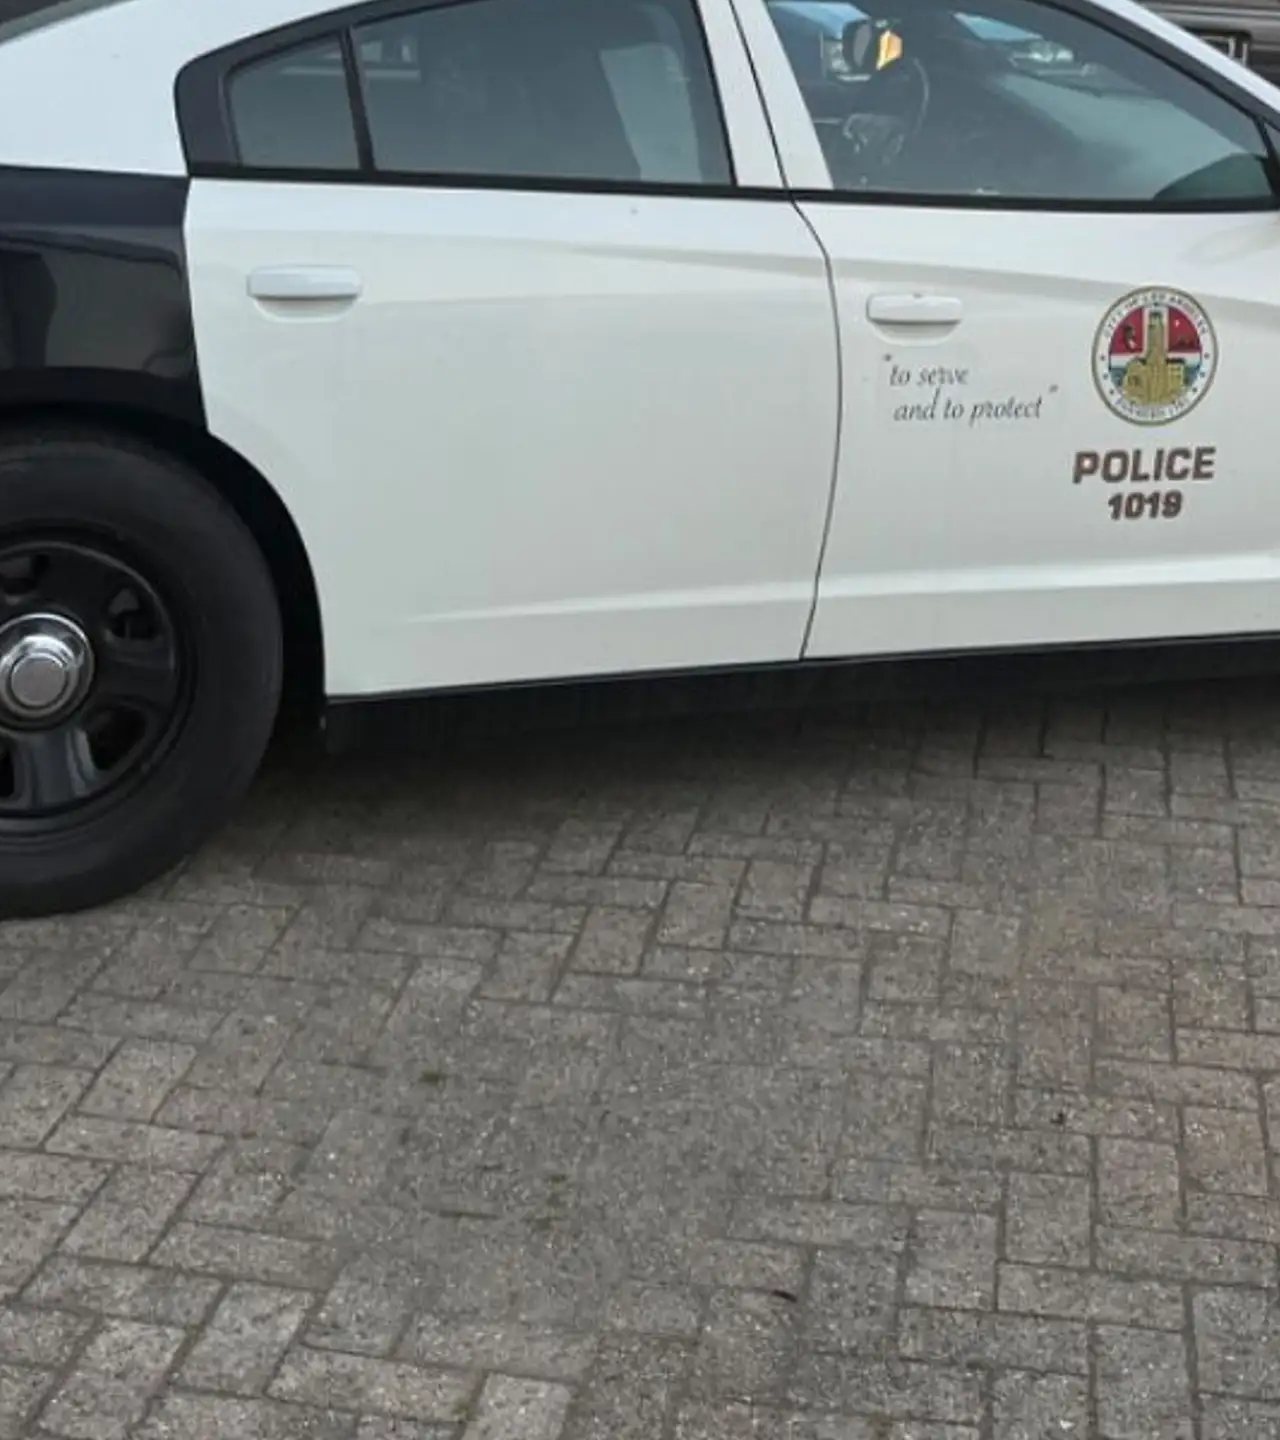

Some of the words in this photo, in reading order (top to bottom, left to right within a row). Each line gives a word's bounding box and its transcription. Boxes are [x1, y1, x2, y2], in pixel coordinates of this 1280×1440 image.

[917, 364, 969, 386] serve
[892, 387, 940, 421] and
[942, 397, 965, 420] to
[1072, 446, 1217, 484] POLICE
[1107, 489, 1184, 520] 1019
